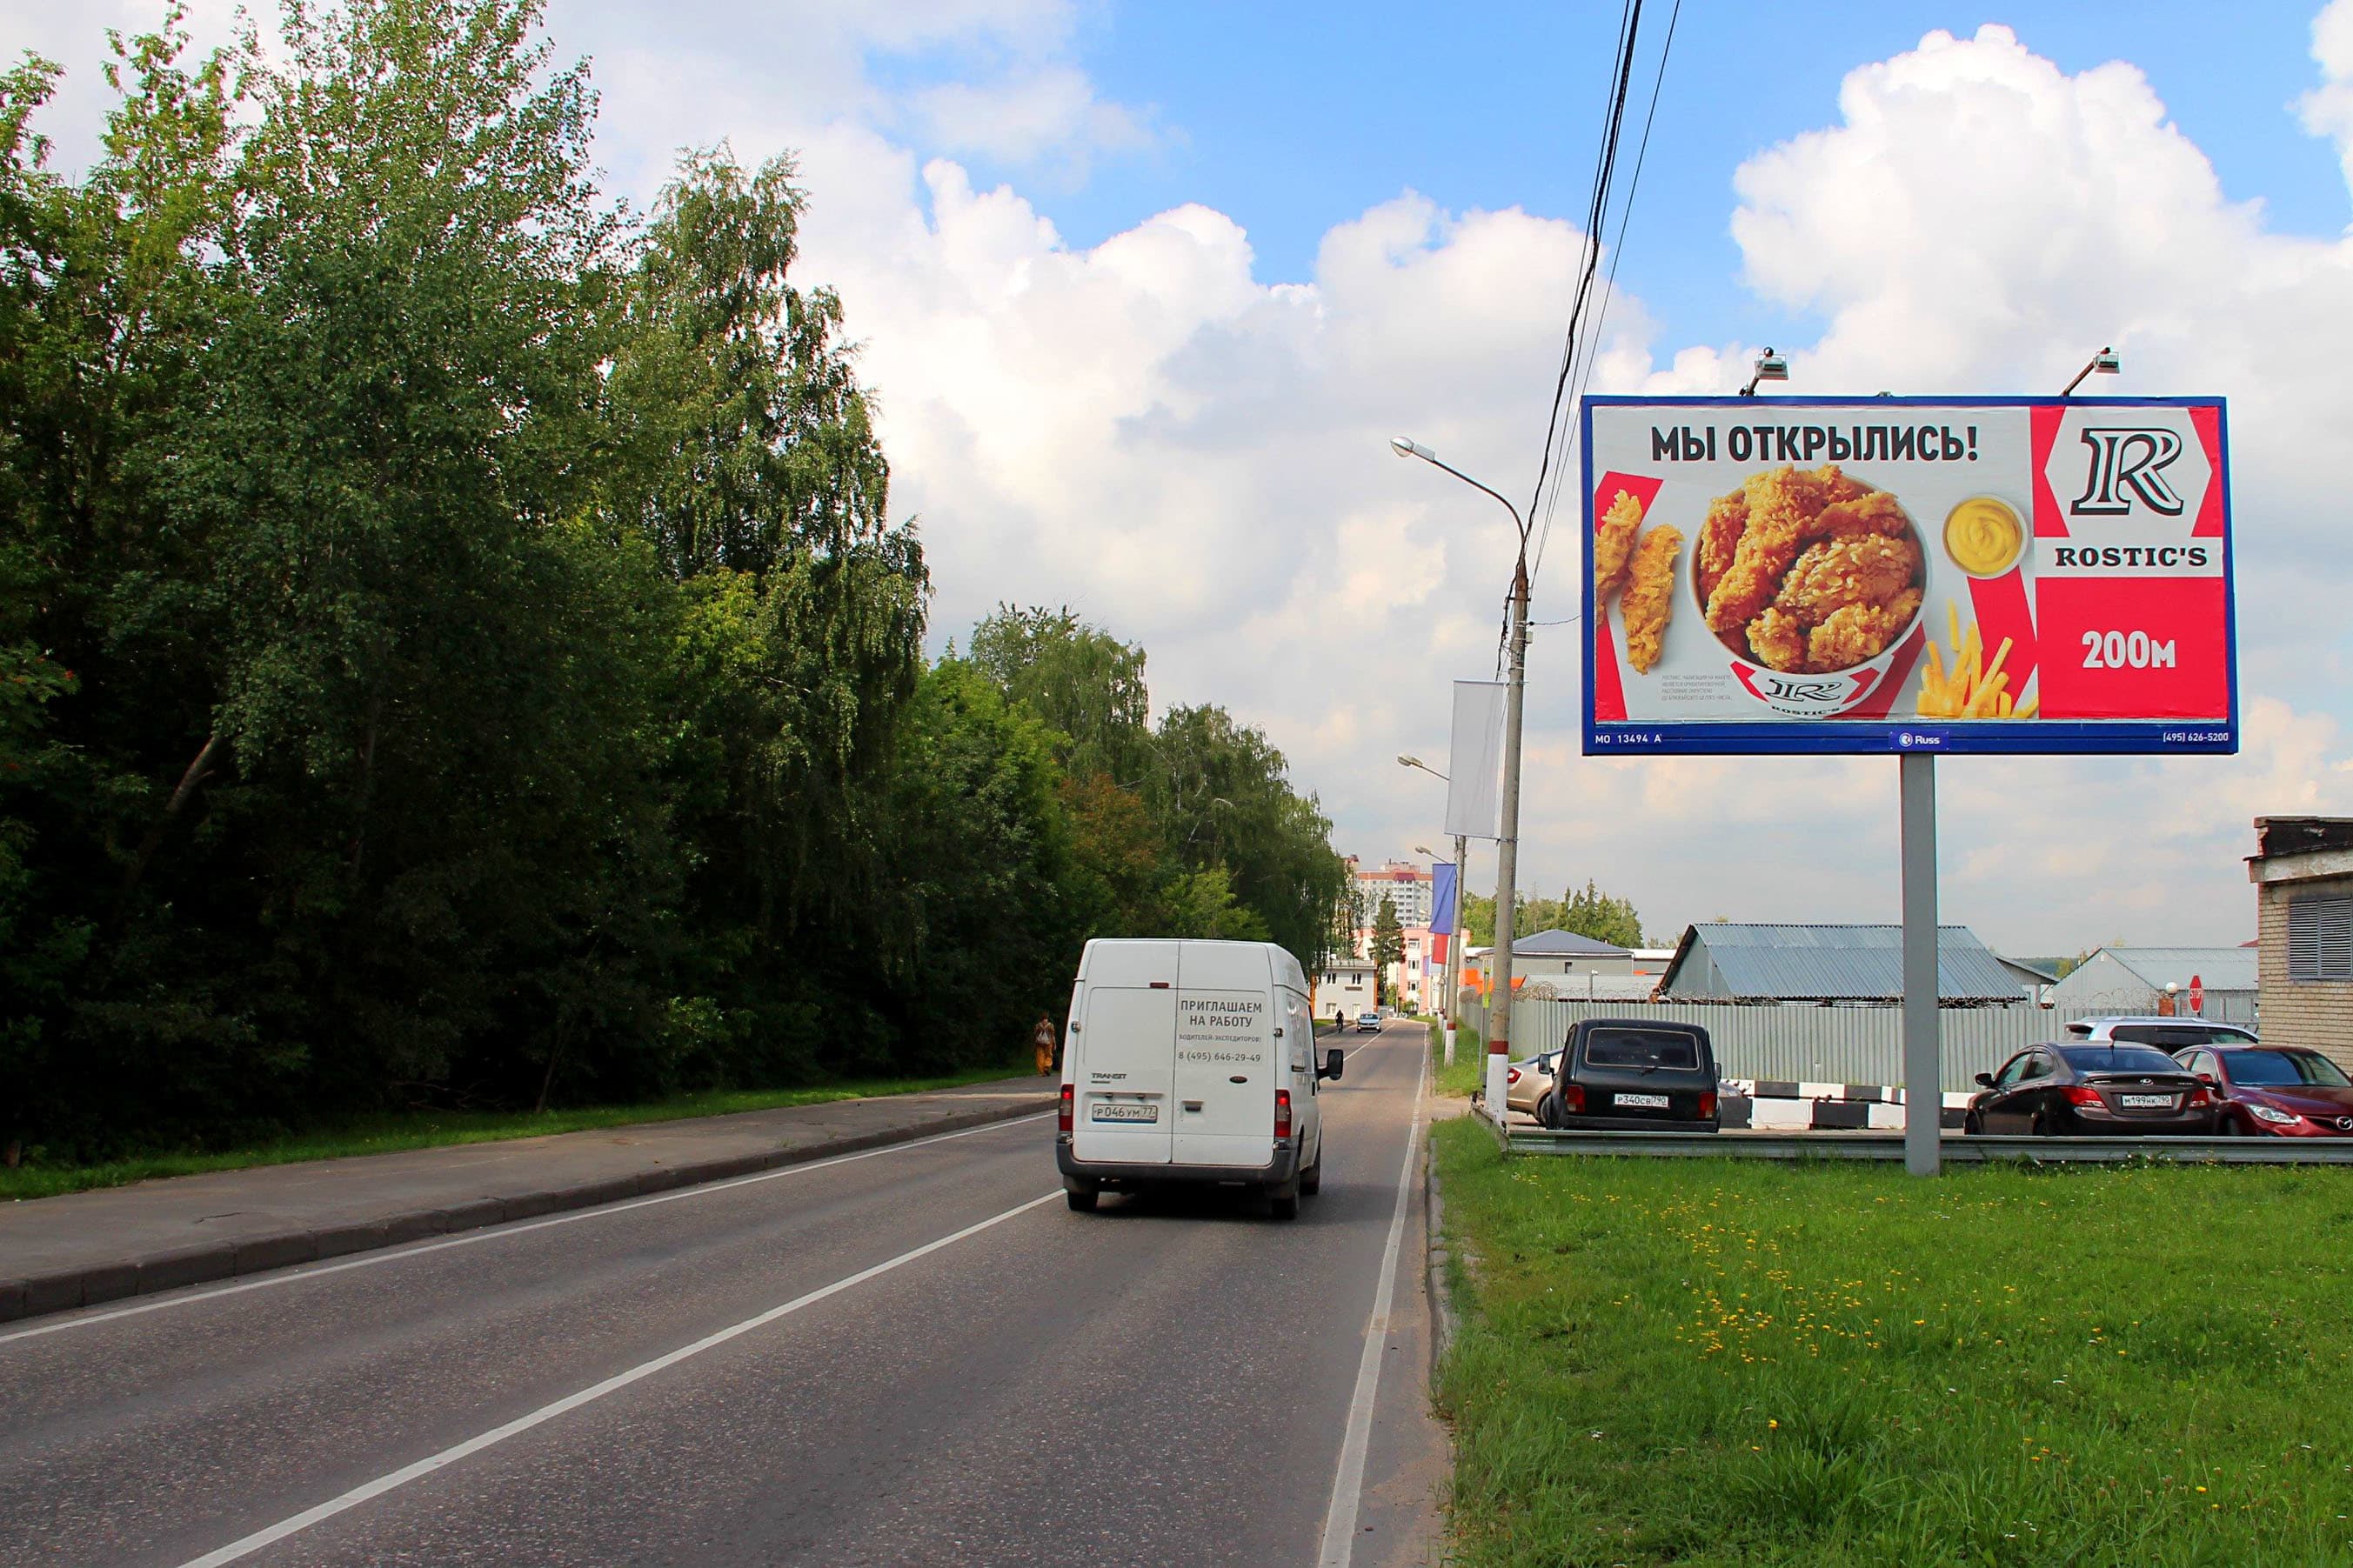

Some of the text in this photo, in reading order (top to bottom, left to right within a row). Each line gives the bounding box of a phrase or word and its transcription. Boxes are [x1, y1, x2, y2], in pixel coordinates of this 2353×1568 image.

[1651, 425, 1978, 462] МЫ ОТКРЫЛИСЬ!
[2055, 546, 2208, 567] ROSTIC'S
[1617, 733, 1649, 744] 13494
[1915, 735, 1941, 745] Russ
[2162, 732, 2229, 744] (495) 626-5200
[1180, 1000, 1262, 1013] ПРИГЛАШАЕМ
[1189, 1015, 1253, 1028] НА РАБОТУ
[1178, 1051, 1261, 1063] 8 (495) 646-29-49
